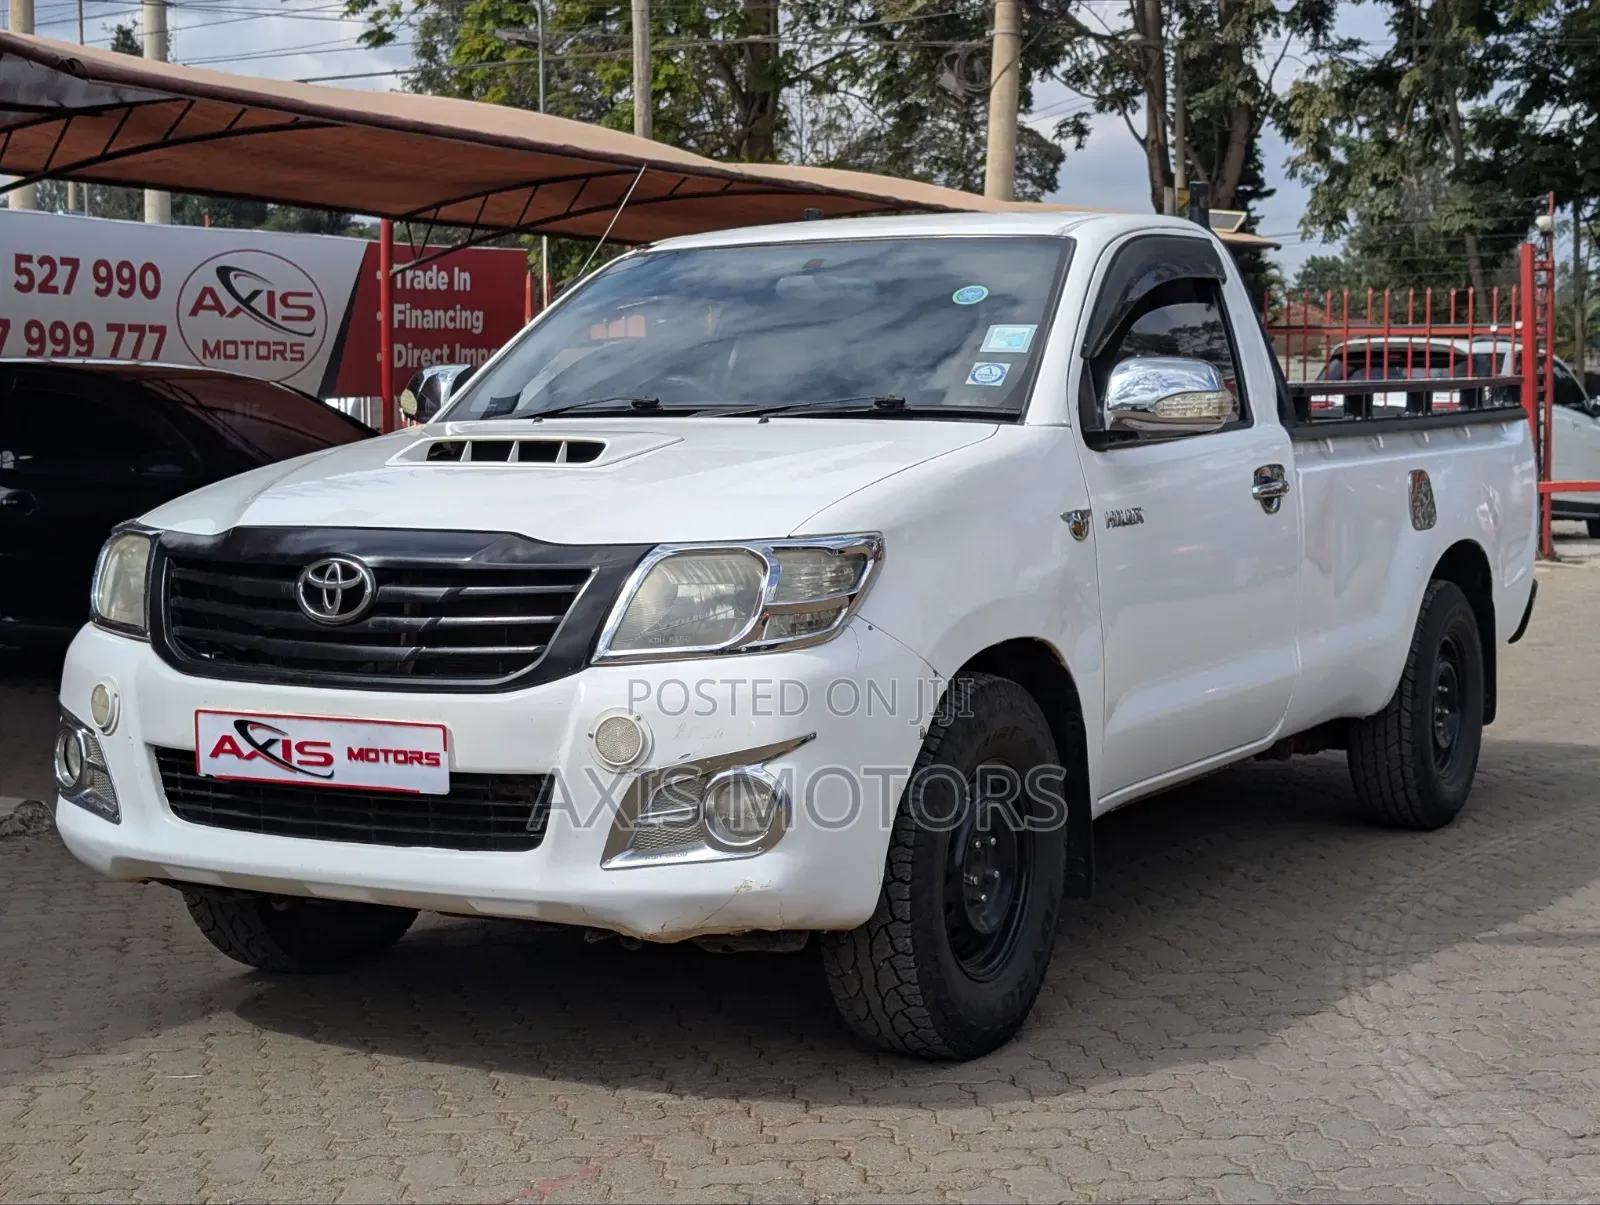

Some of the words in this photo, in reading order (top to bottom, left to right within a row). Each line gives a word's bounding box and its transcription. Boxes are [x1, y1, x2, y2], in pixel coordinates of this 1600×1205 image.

[14, 253, 80, 295] 527
[92, 258, 161, 300] 990
[390, 263, 449, 290] Trade
[453, 266, 471, 291] In
[188, 272, 316, 334] AXIS
[393, 302, 484, 334] Financing
[23, 318, 95, 358] 999
[106, 322, 167, 360] 777
[202, 338, 305, 362] MOTORS
[393, 342, 450, 369] Direct
[209, 724, 334, 774] AXIS
[347, 746, 441, 767] MOTORS
